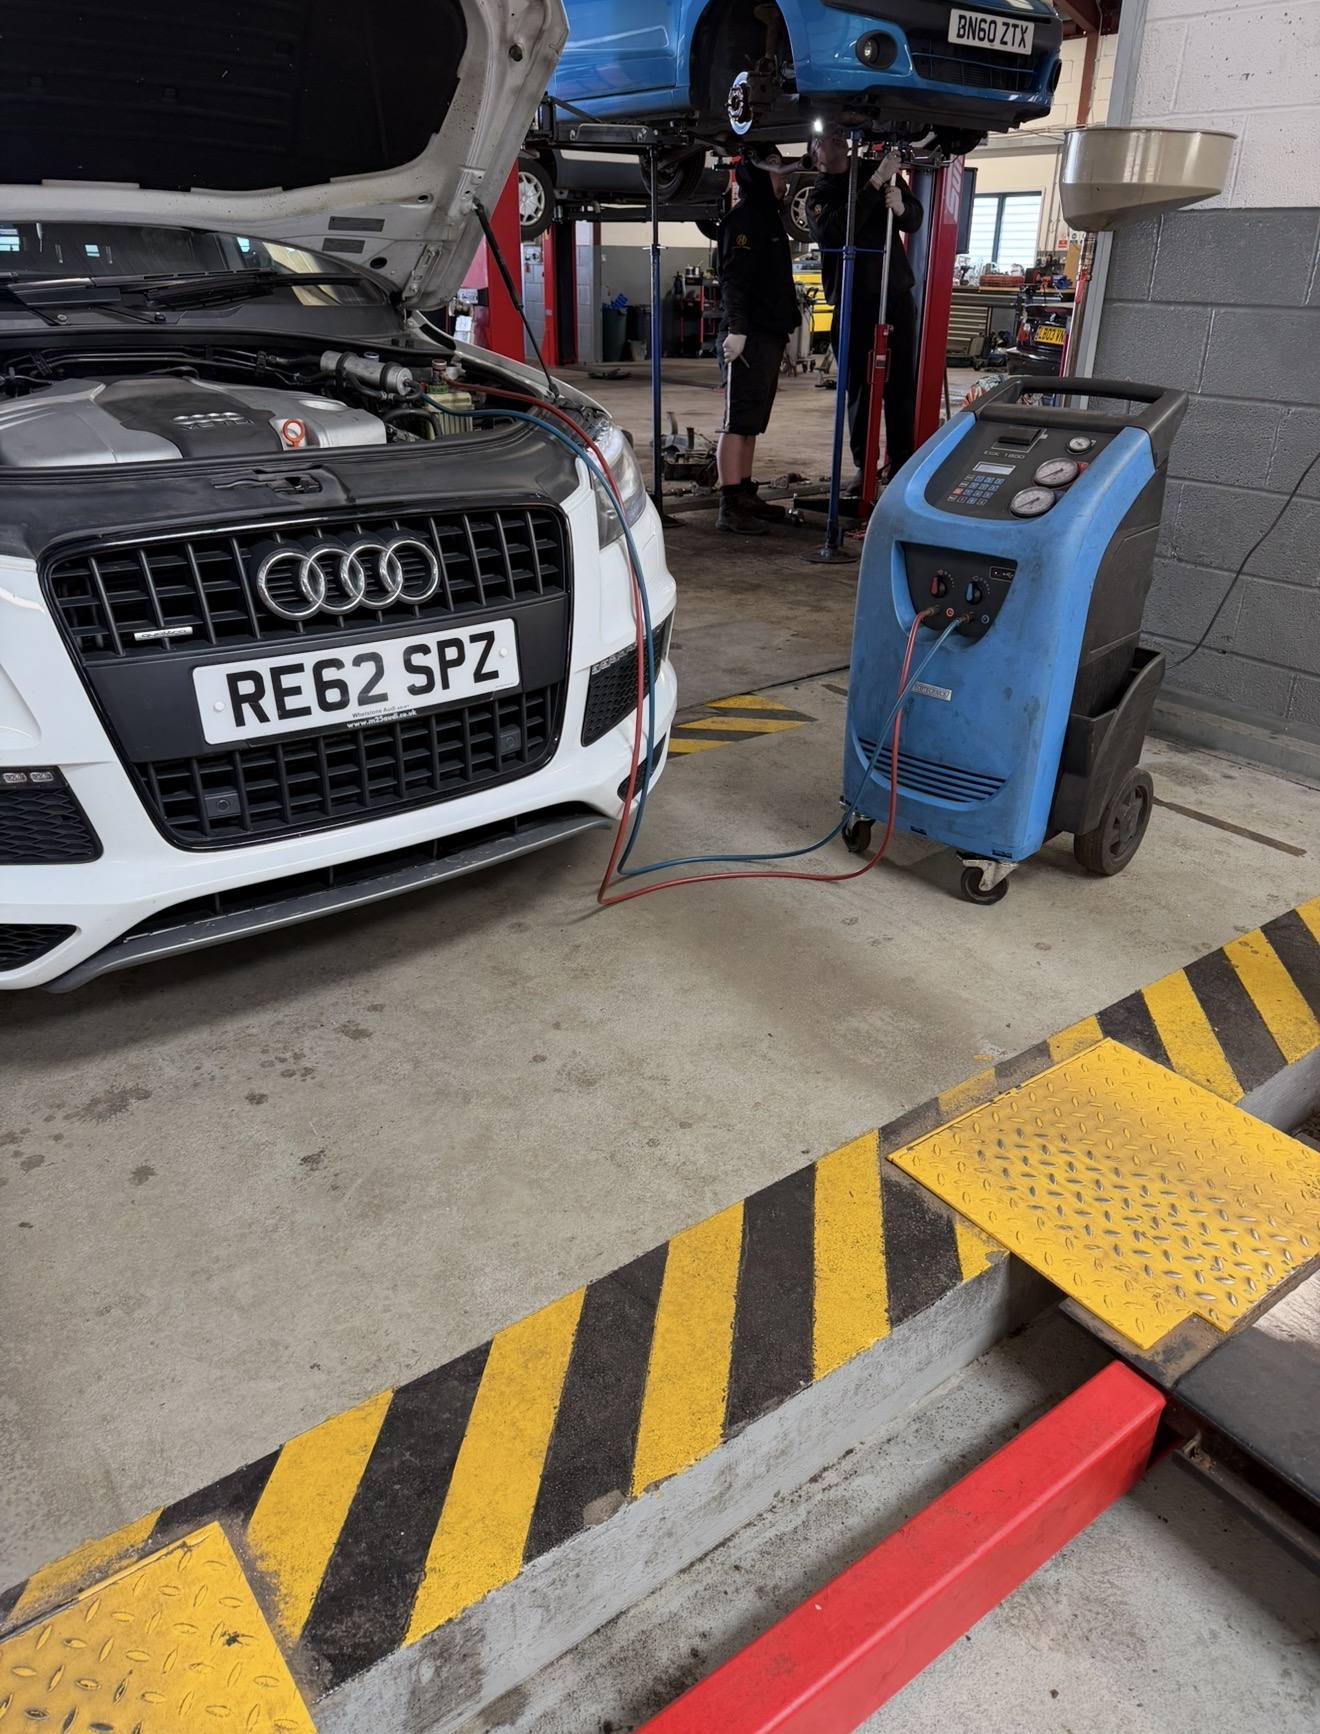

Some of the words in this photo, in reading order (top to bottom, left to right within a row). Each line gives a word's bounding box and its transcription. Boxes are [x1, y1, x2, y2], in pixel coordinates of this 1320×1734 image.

[956, 14, 998, 44] BN60
[1000, 21, 1029, 49] ZTX
[225, 651, 389, 727] RE62
[402, 630, 500, 696] SPZ
[346, 709, 418, 729] www.m25audi.co.uk
[383, 705, 397, 713] Audi
